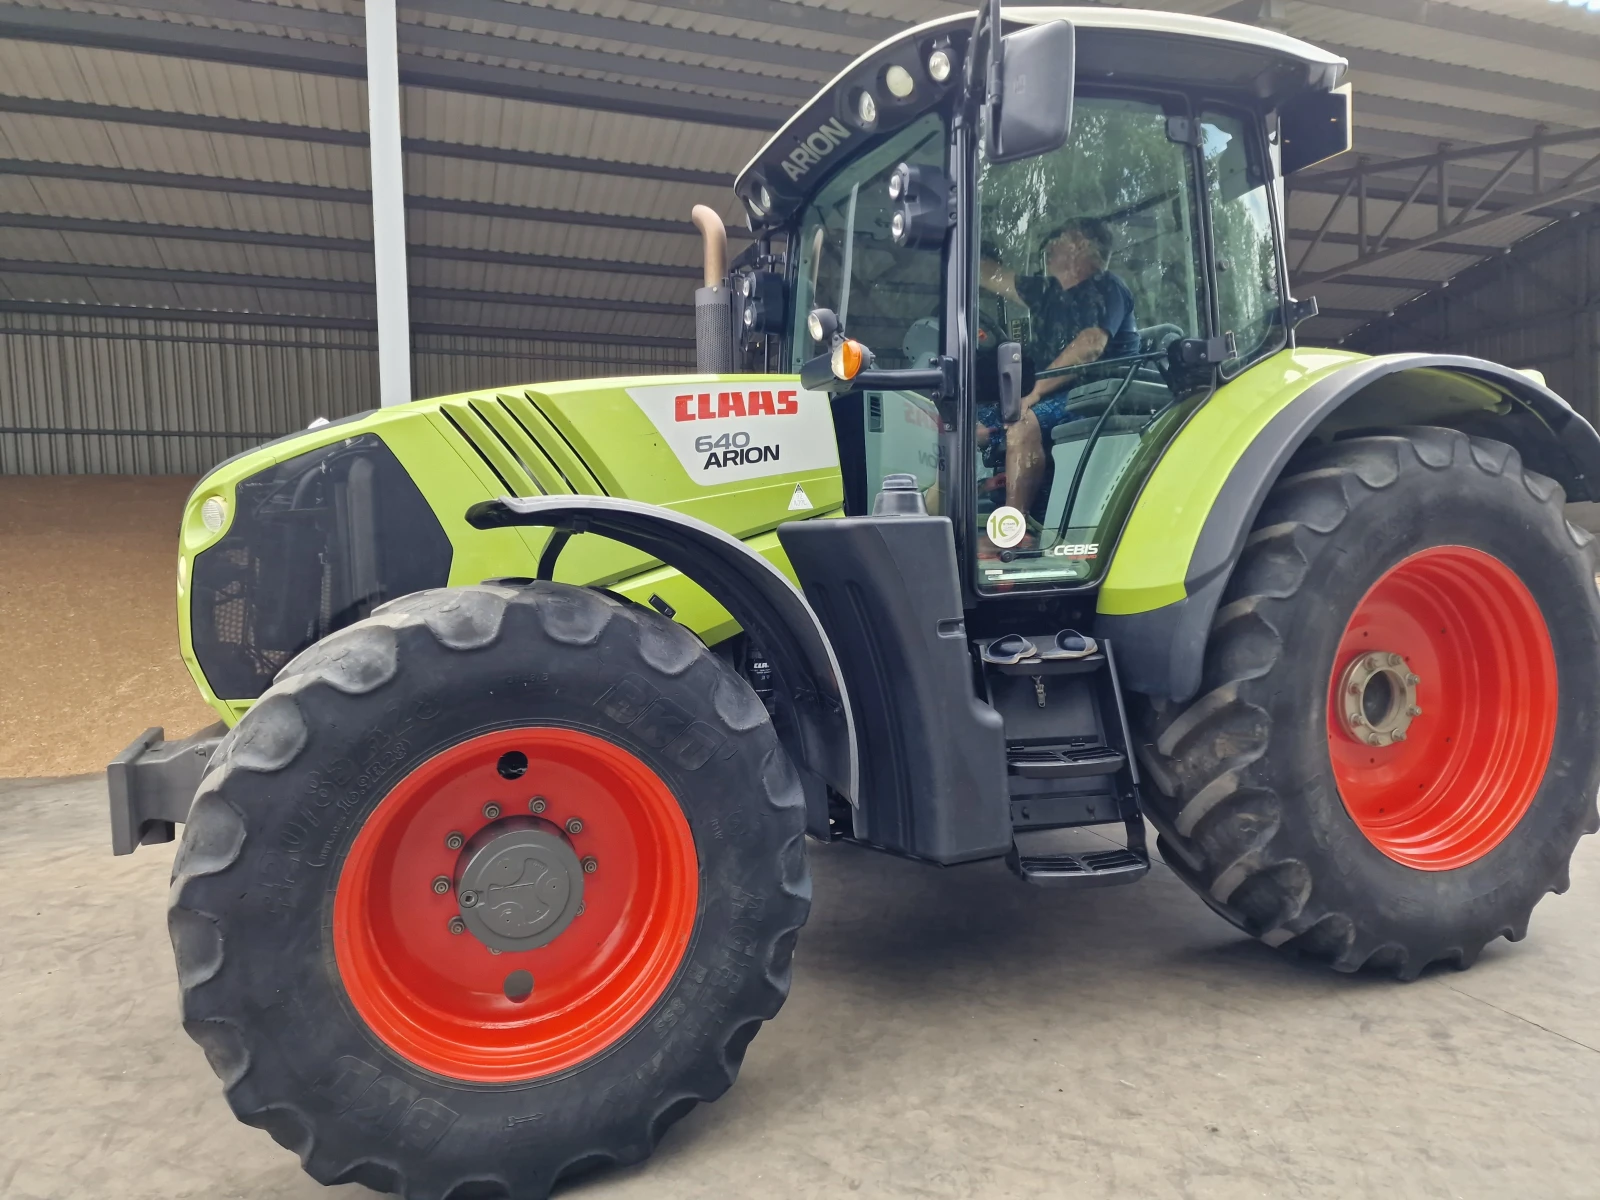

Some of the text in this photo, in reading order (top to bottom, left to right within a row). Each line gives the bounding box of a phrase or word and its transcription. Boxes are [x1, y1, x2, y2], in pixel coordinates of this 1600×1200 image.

[781, 116, 851, 181] ARION
[675, 390, 798, 422] CLAAS
[695, 431, 750, 453] 640
[703, 444, 780, 470] ARION
[990, 514, 1020, 539] 10
[1053, 543, 1100, 556] CEBIS
